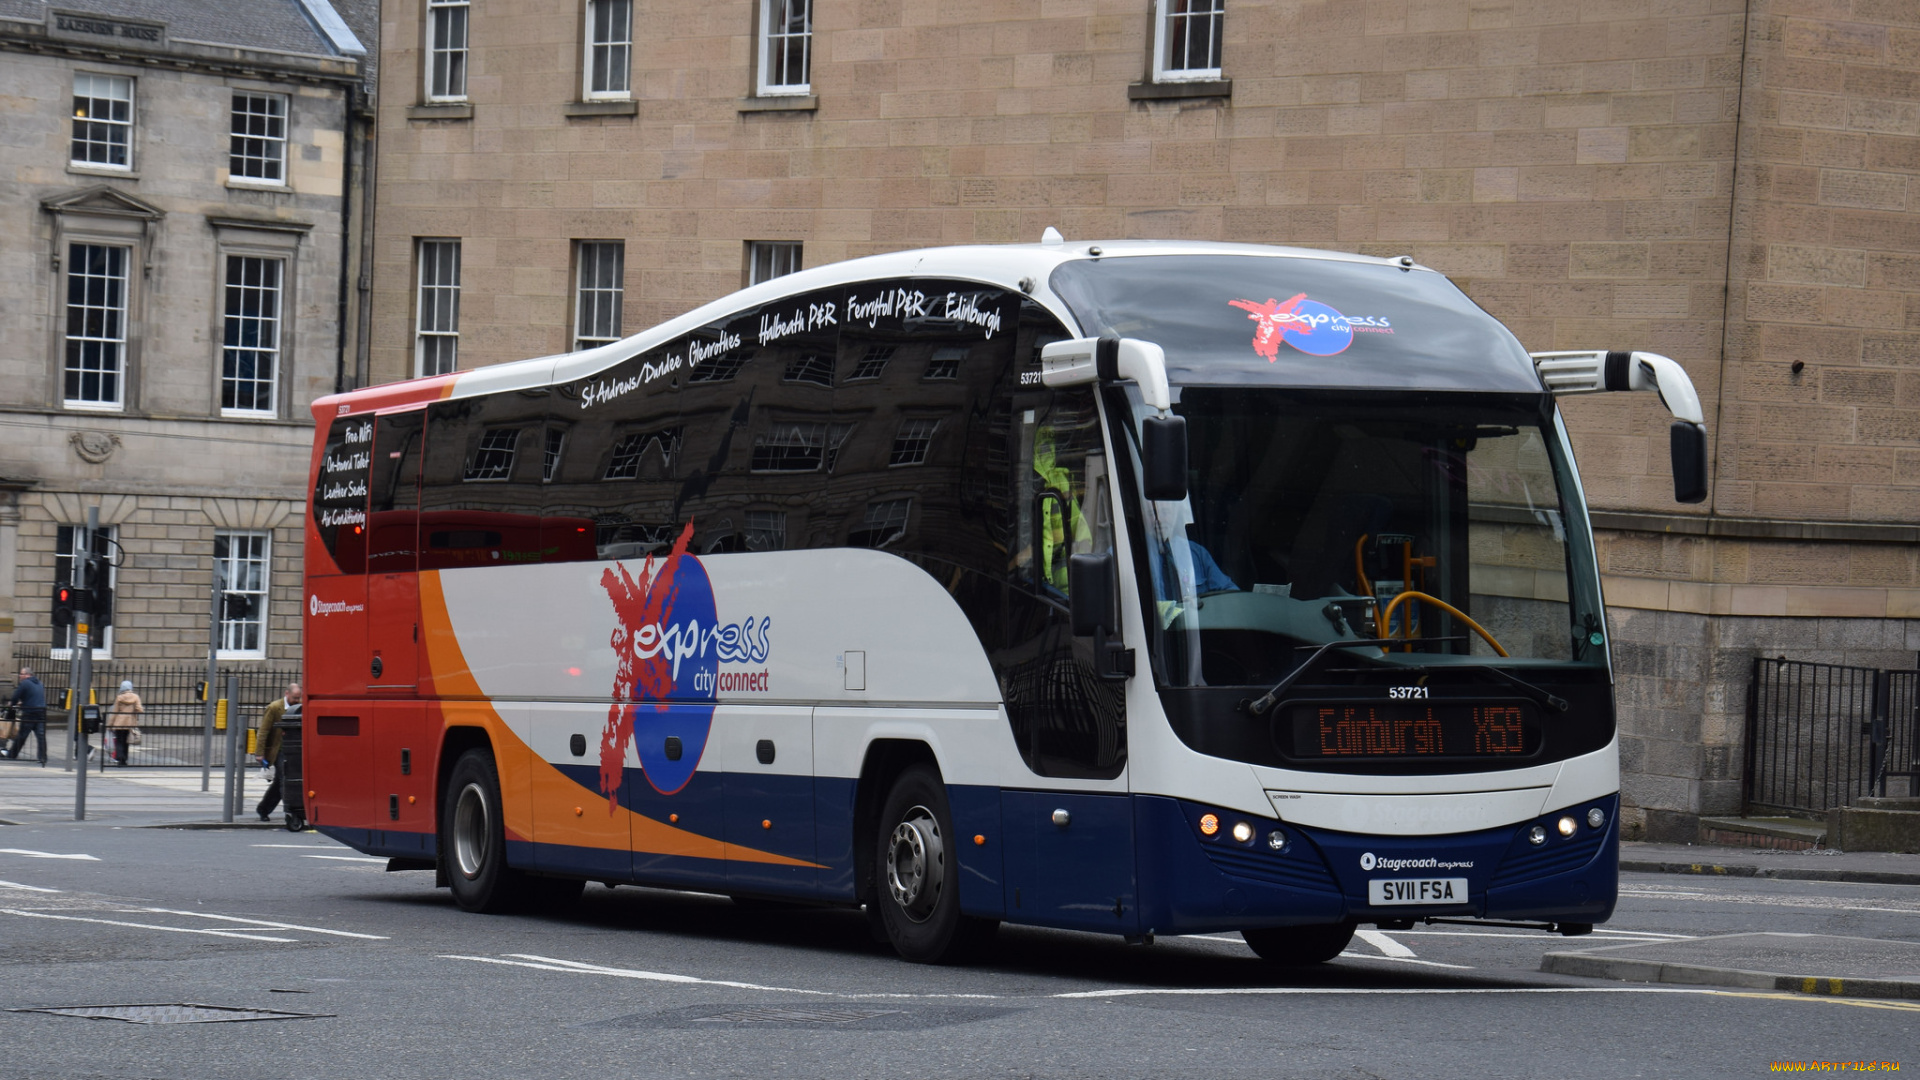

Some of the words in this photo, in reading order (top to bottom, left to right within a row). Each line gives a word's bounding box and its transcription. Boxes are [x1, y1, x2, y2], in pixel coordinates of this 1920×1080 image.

[121, 25, 159, 41] HOUSE
[1269, 313, 1391, 328] express
[1331, 324, 1350, 333] city
[1352, 326, 1395, 334] connect
[581, 384, 596, 409] St
[689, 330, 741, 368] Glenrothes
[759, 308, 805, 346] Halbeath
[808, 302, 837, 332] P&R
[847, 289, 892, 328] Ferrytoll
[895, 288, 925, 318] P&R
[945, 292, 1000, 340] Edinburgh
[1020, 371, 1041, 384] 53721
[345, 427, 358, 444] Free
[327, 454, 352, 473] On-board
[354, 451, 370, 469] Toilet
[324, 482, 348, 500] Leather
[348, 479, 367, 498] Seats
[322, 510, 332, 527] Air
[332, 508, 365, 530] Conditioning
[318, 600, 345, 616] Stagecoach
[345, 604, 364, 614] express
[634, 616, 771, 682] express
[694, 666, 716, 698] city
[719, 668, 769, 692] connect
[1388, 687, 1429, 699] 53721
[1319, 708, 1444, 754] Edinburgh
[1473, 707, 1523, 753] X59
[1376, 857, 1436, 871] Stagecoach
[1437, 860, 1474, 870] express
[1383, 881, 1416, 900] SV11
[1420, 881, 1454, 900] FSA
